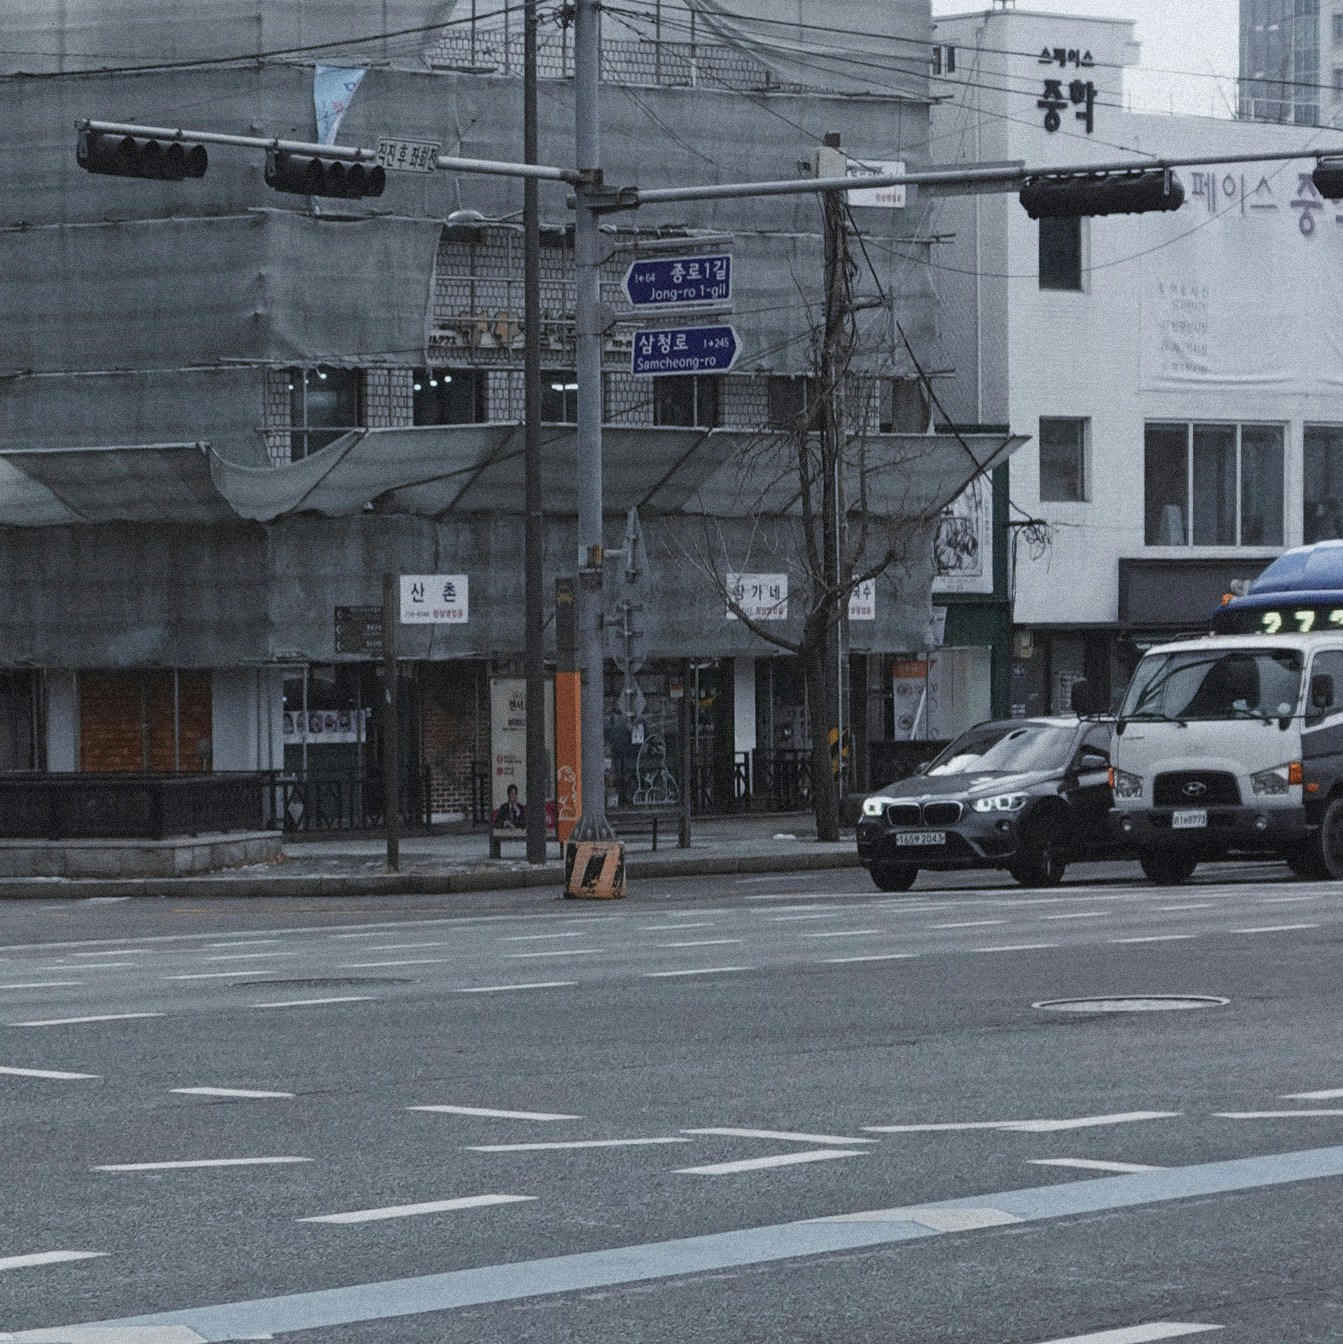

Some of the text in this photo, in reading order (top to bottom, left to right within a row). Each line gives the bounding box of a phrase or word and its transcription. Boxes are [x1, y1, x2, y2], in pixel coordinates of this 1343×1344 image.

[1038, 47, 1095, 68] 스페이스
[1037, 79, 1098, 134] 중학
[378, 143, 437, 172] 직진 후 좌회전
[1181, 172, 1278, 214] 페이스
[670, 259, 726, 284] 종로1길
[650, 284, 726, 301] Jong-ro 1-gil
[639, 333, 689, 355] 삼청로
[637, 356, 717, 371] Samcheong-ro
